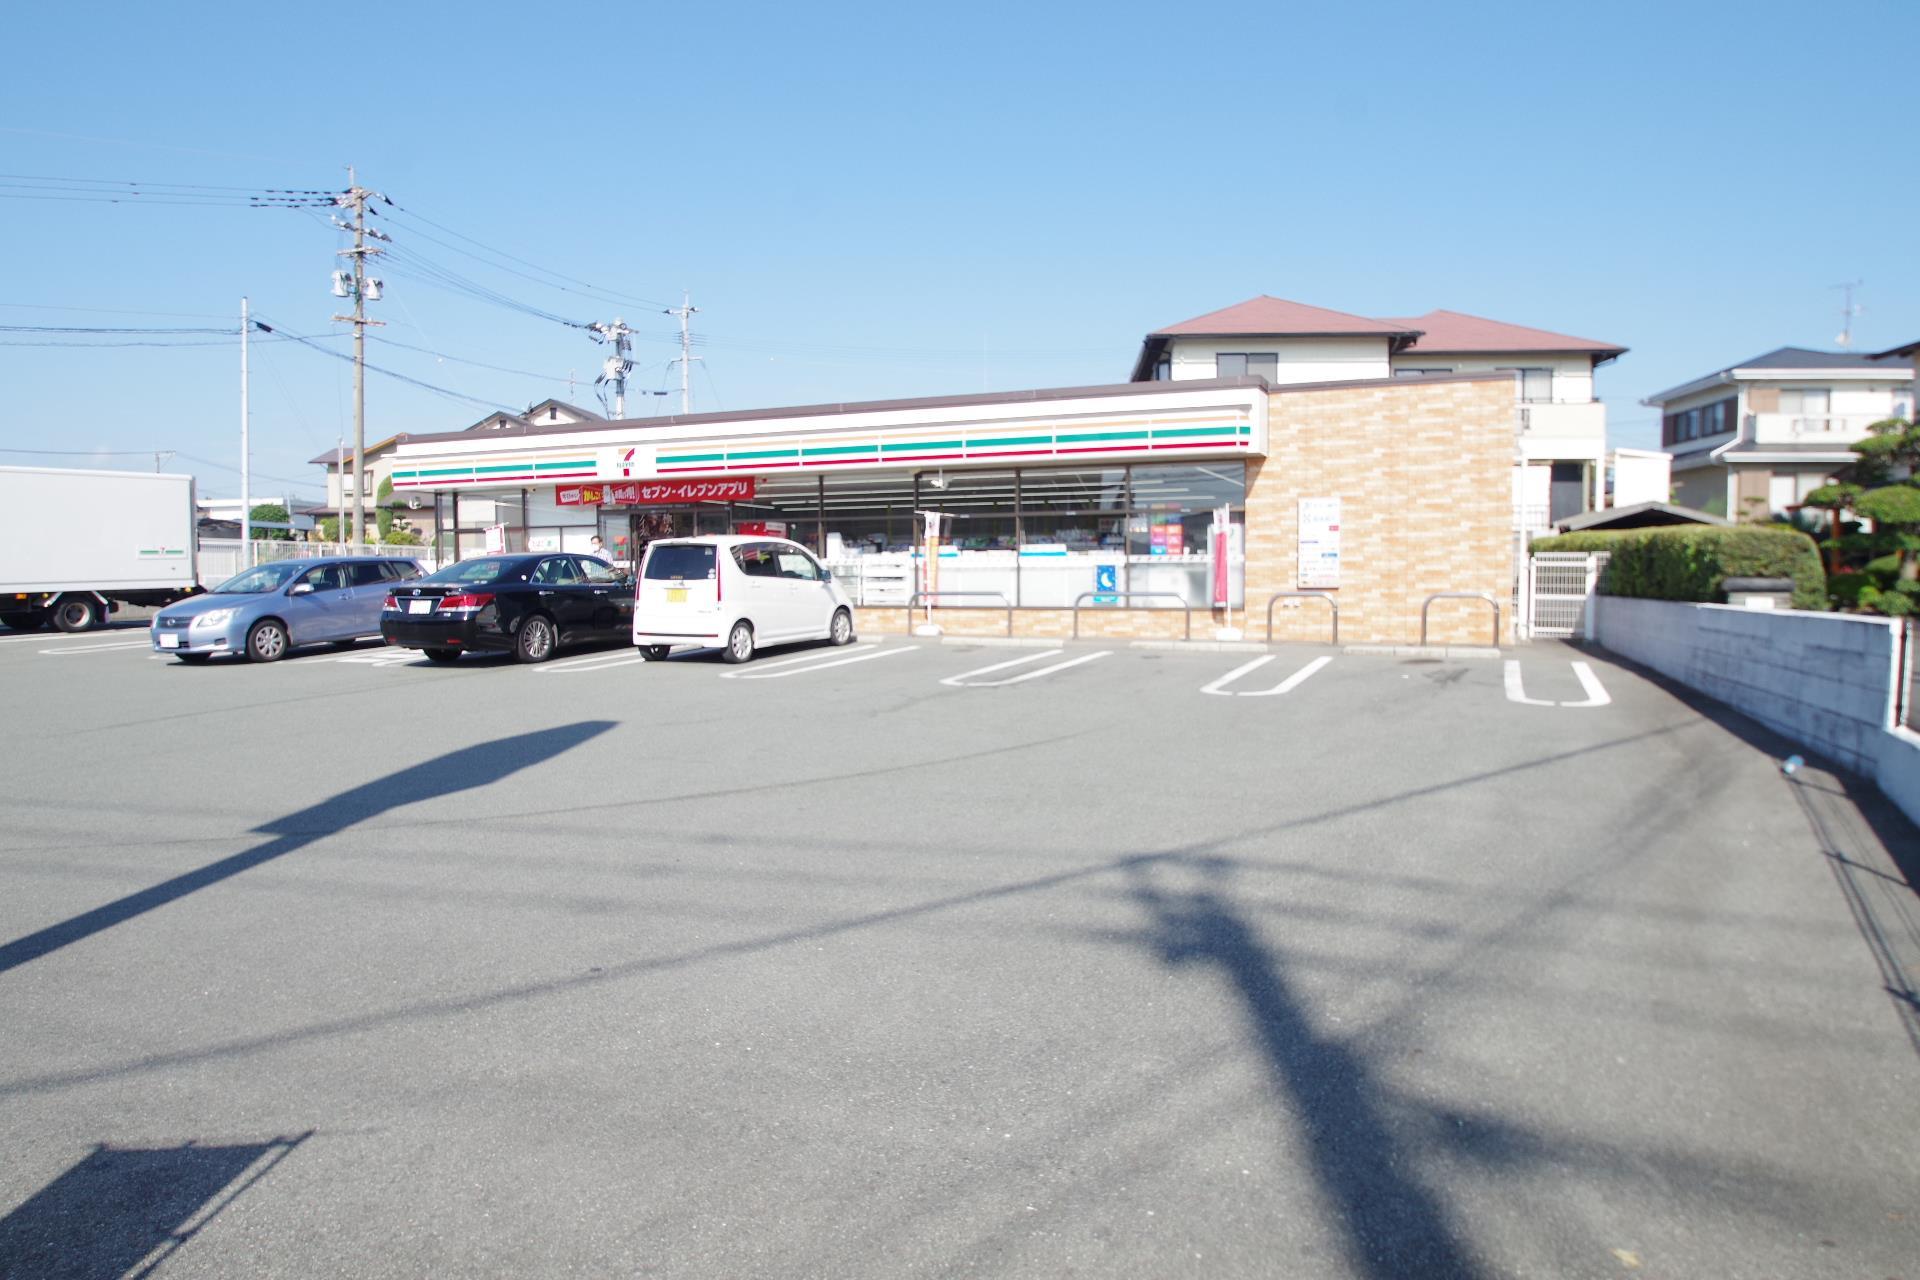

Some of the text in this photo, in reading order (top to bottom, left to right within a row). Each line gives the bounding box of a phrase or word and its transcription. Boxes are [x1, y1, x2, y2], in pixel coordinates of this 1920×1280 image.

[641, 481, 748, 499] セブン-イレブンアプリ
